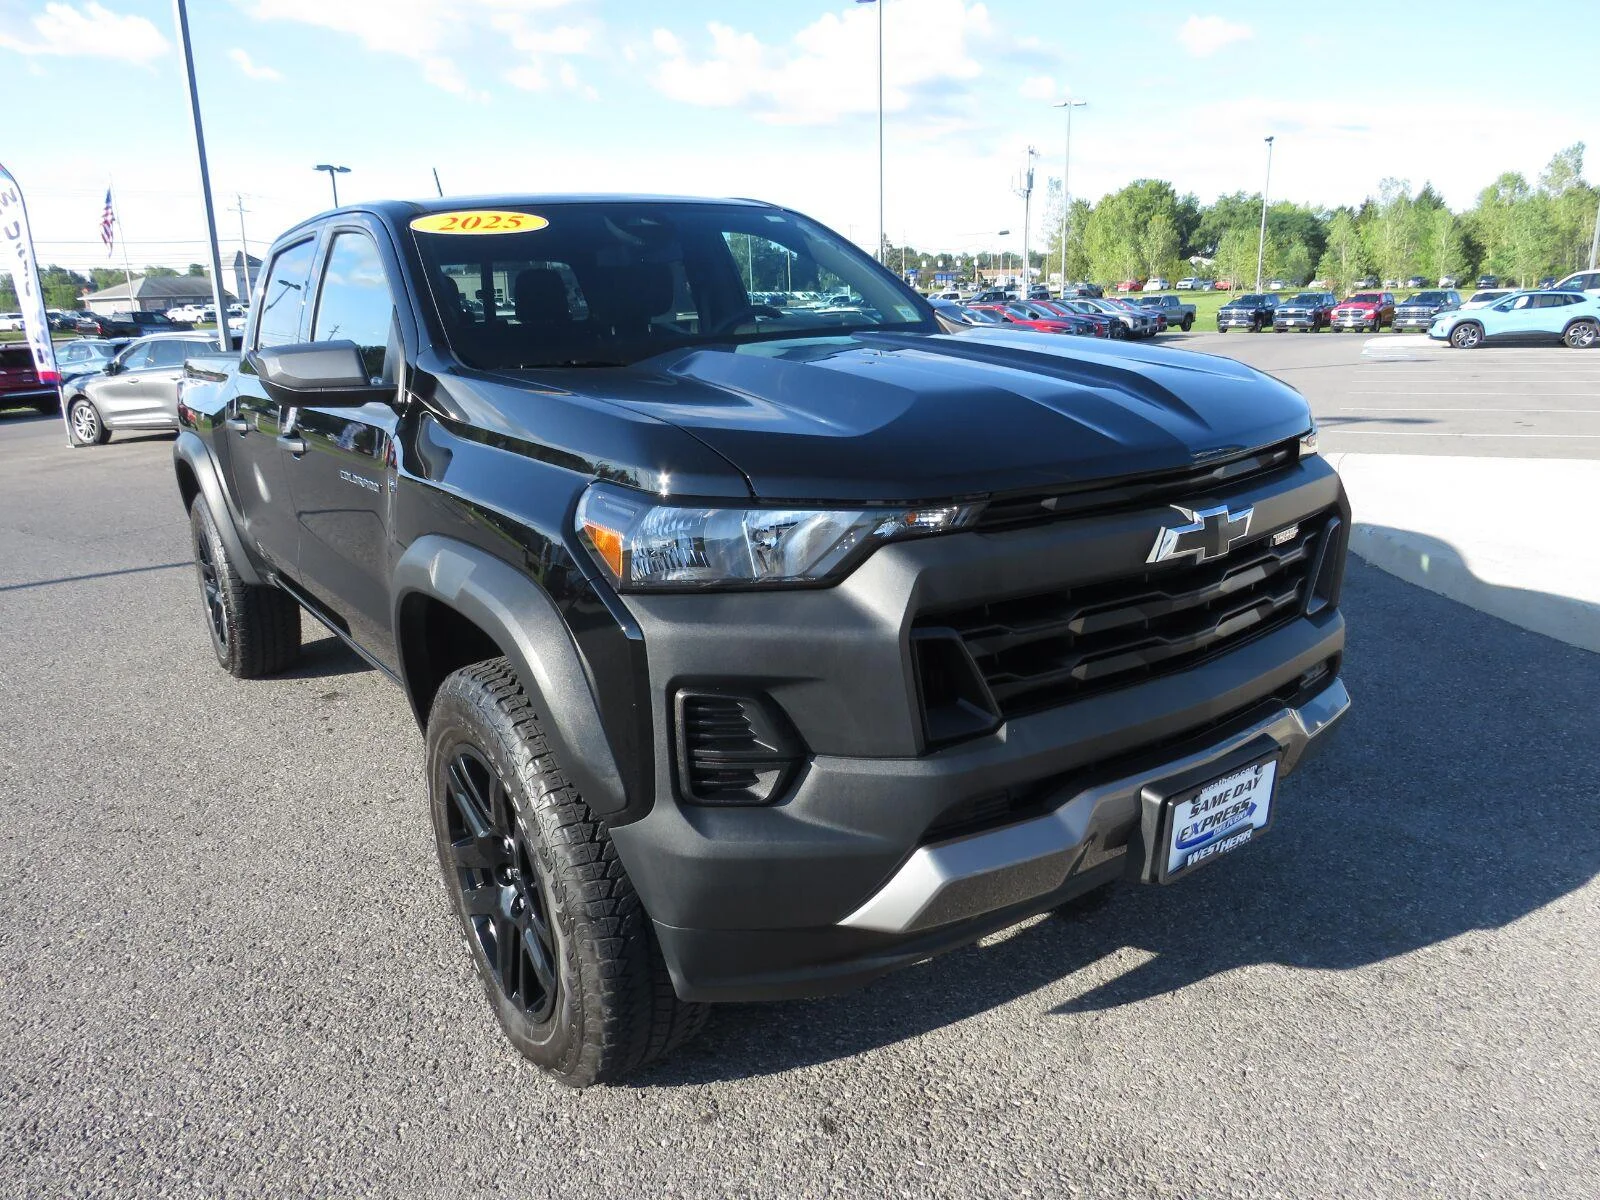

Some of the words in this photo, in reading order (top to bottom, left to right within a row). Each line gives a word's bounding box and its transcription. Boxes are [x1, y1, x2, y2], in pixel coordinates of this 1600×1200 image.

[438, 215, 524, 231] 2025
[1188, 788, 1233, 819] SAME
[1232, 773, 1263, 799] DAY
[1180, 797, 1252, 842] EXPRESS
